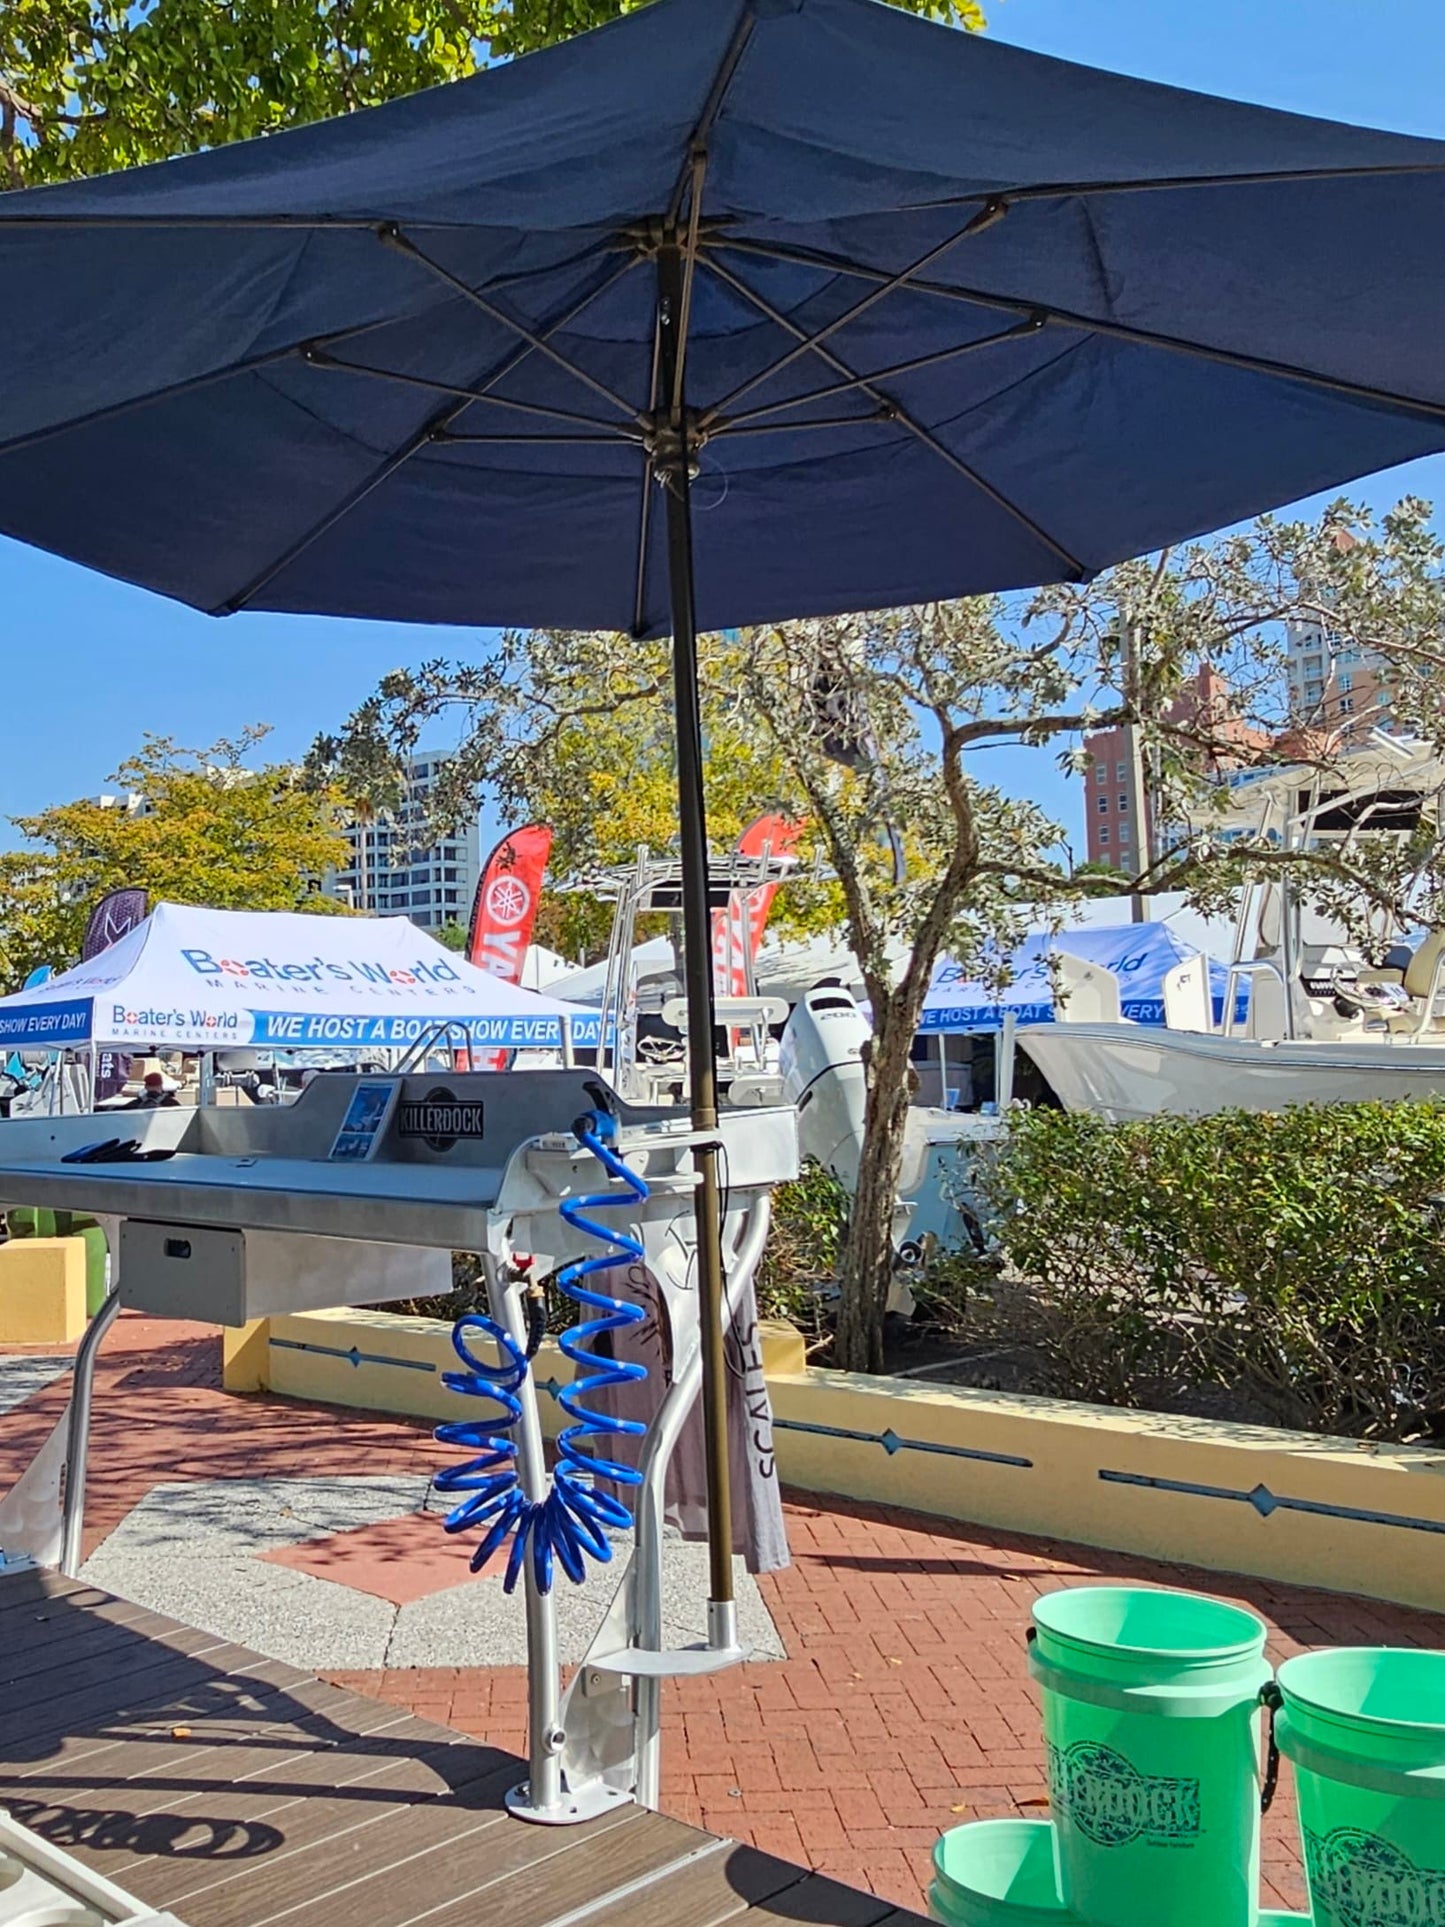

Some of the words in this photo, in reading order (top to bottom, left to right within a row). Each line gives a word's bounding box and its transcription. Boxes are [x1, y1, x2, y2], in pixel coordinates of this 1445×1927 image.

[181, 949, 352, 981] Boater's
[349, 958, 462, 985] World
[206, 979, 330, 995] MARINE
[27, 1014, 62, 1032] EVERY
[61, 1011, 87, 1030] DAY!
[112, 1004, 186, 1027] Boater's
[192, 1009, 238, 1029] World
[940, 1006, 982, 1023] HOST
[982, 1006, 996, 1019] A
[1121, 1003, 1166, 1019] VERY
[112, 1028, 166, 1038] MARINE
[176, 1030, 238, 1041] CENTERS
[267, 1015, 304, 1038] WE
[308, 1016, 371, 1039] HOST
[371, 1018, 386, 1039] A
[450, 1019, 508, 1040] SHOW
[510, 1019, 558, 1040] EVER
[101, 1052, 114, 1079] ats
[400, 1107, 482, 1133] KILLERDOCK
